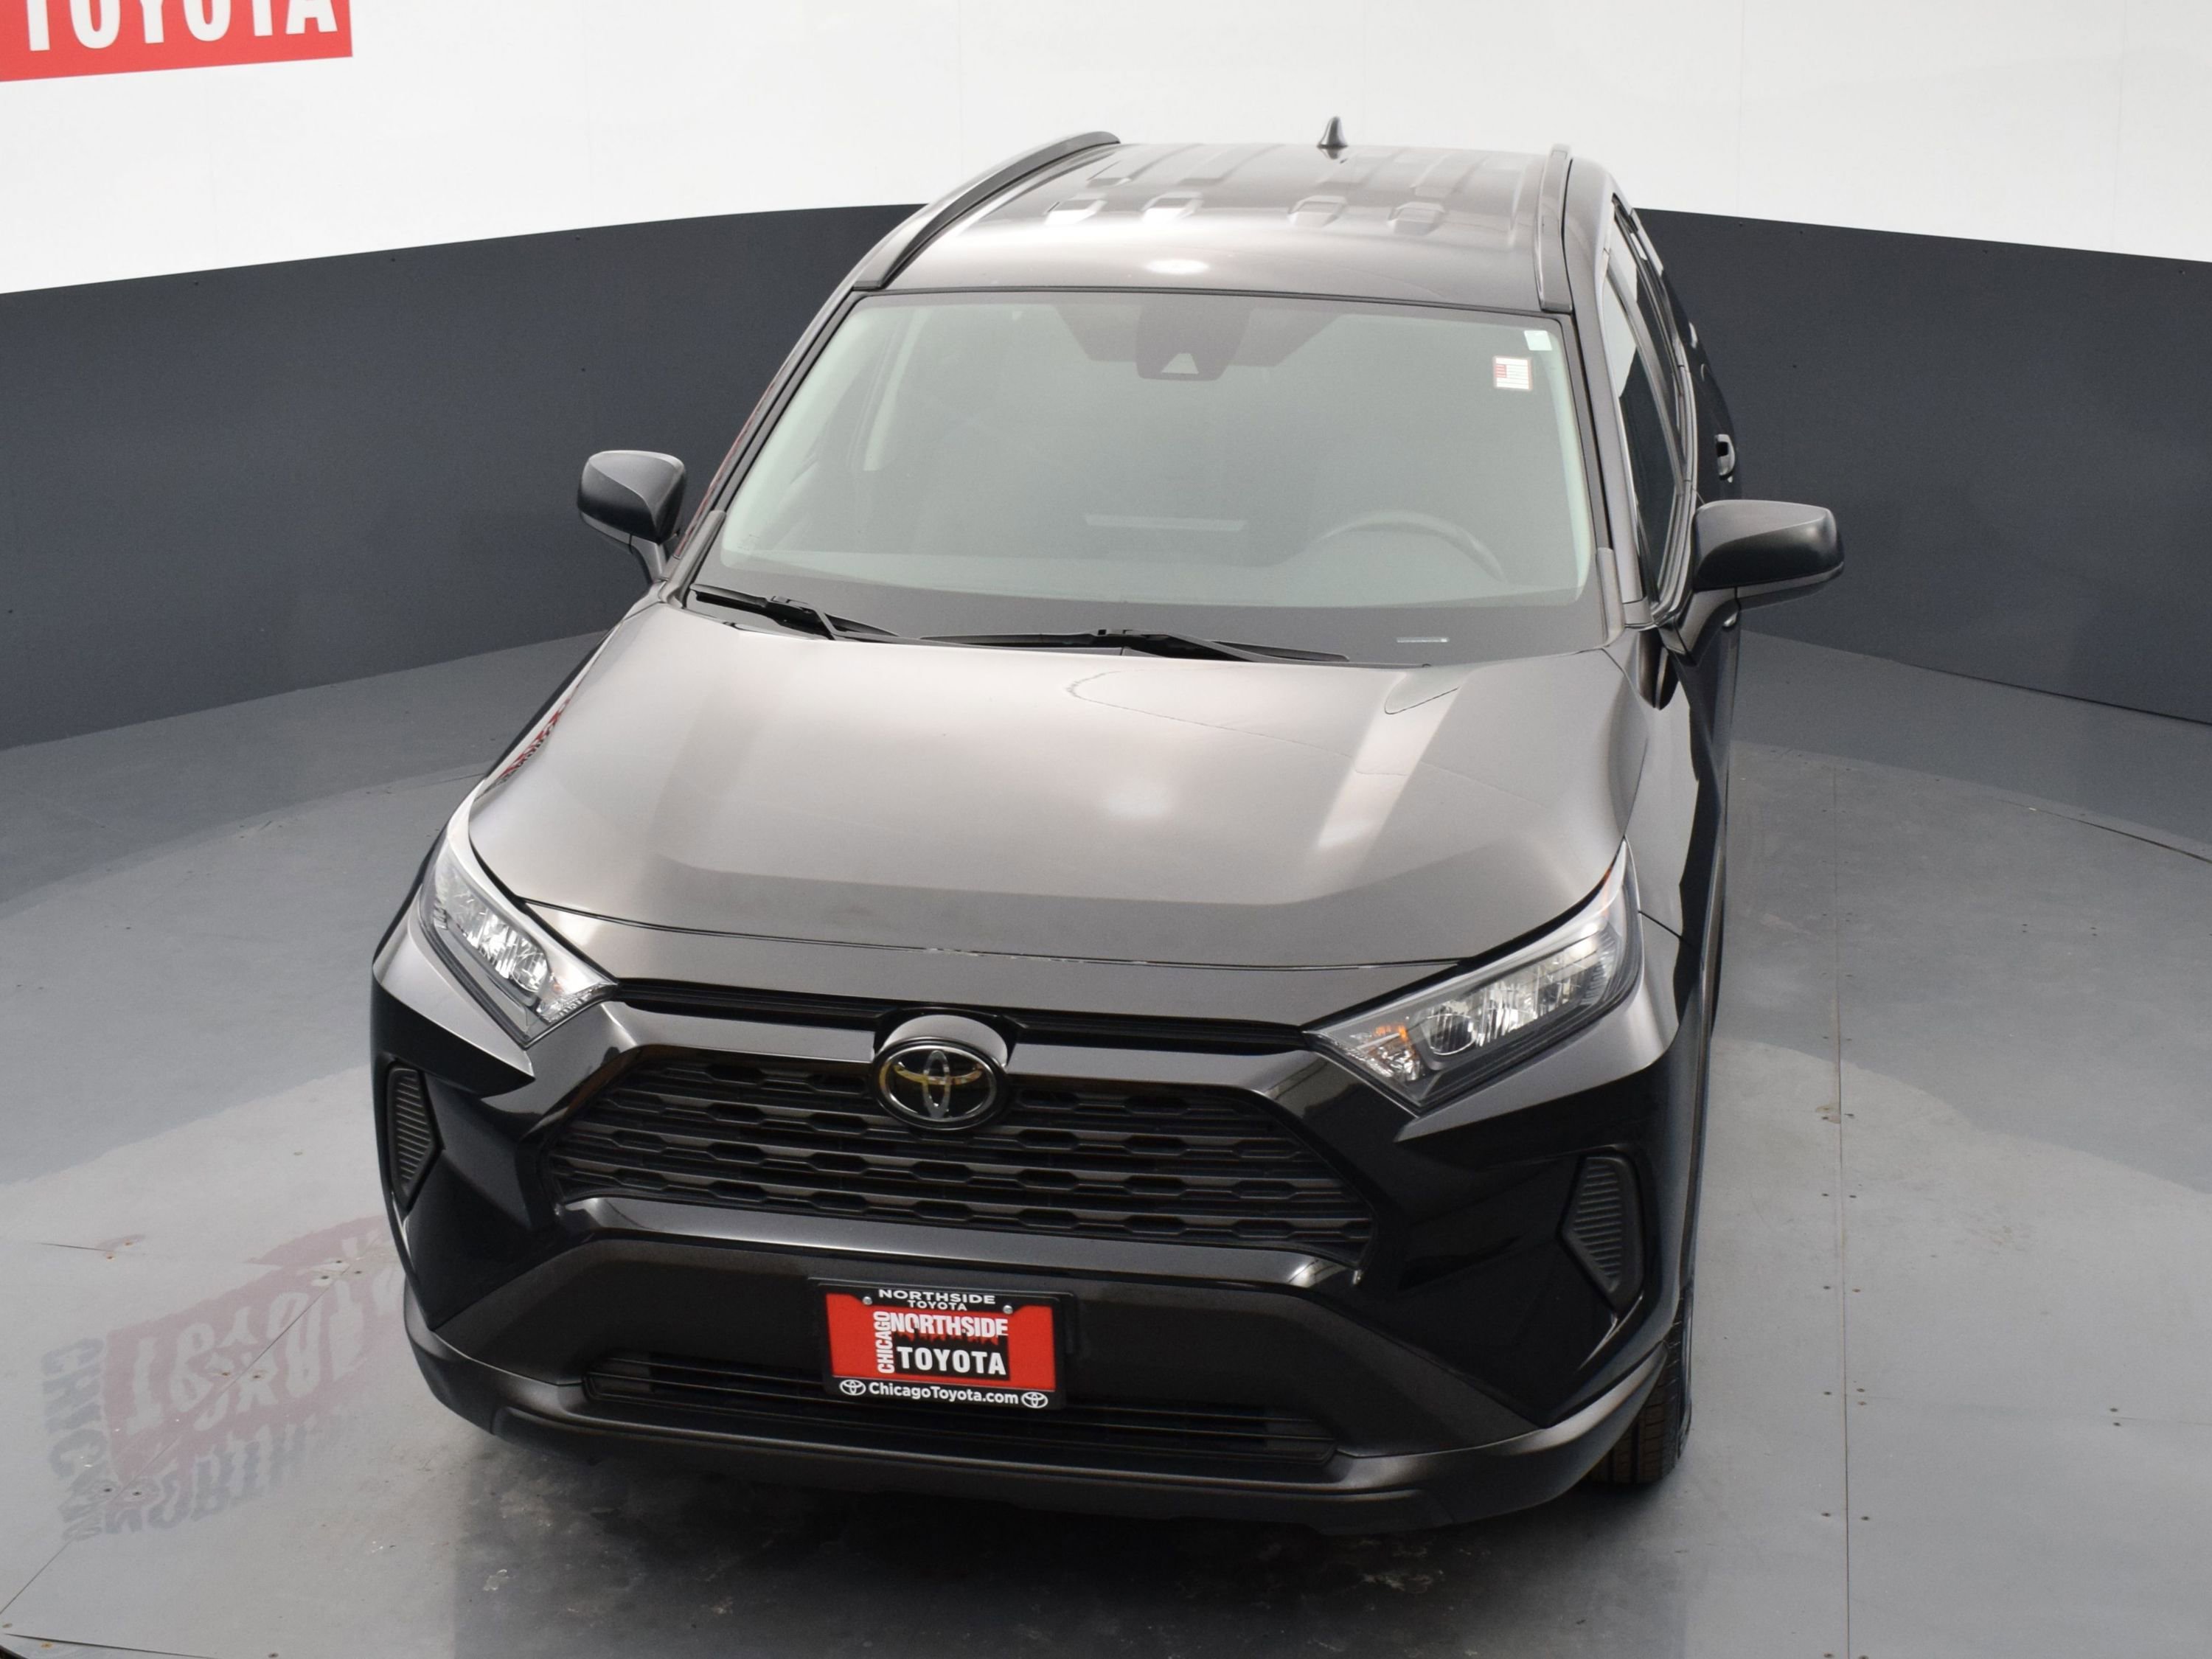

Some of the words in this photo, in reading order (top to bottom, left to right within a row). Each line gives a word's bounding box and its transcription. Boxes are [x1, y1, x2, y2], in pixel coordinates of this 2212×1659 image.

[878, 1289, 995, 1304] NORTHSIDE
[907, 1300, 967, 1311] TOYOTA
[890, 1312, 1009, 1338] NORTHSIDE
[873, 1311, 895, 1374] CHICAGO
[896, 1346, 1006, 1375] TOYOTA
[869, 1382, 1019, 1404] ChicagoToyota.com
